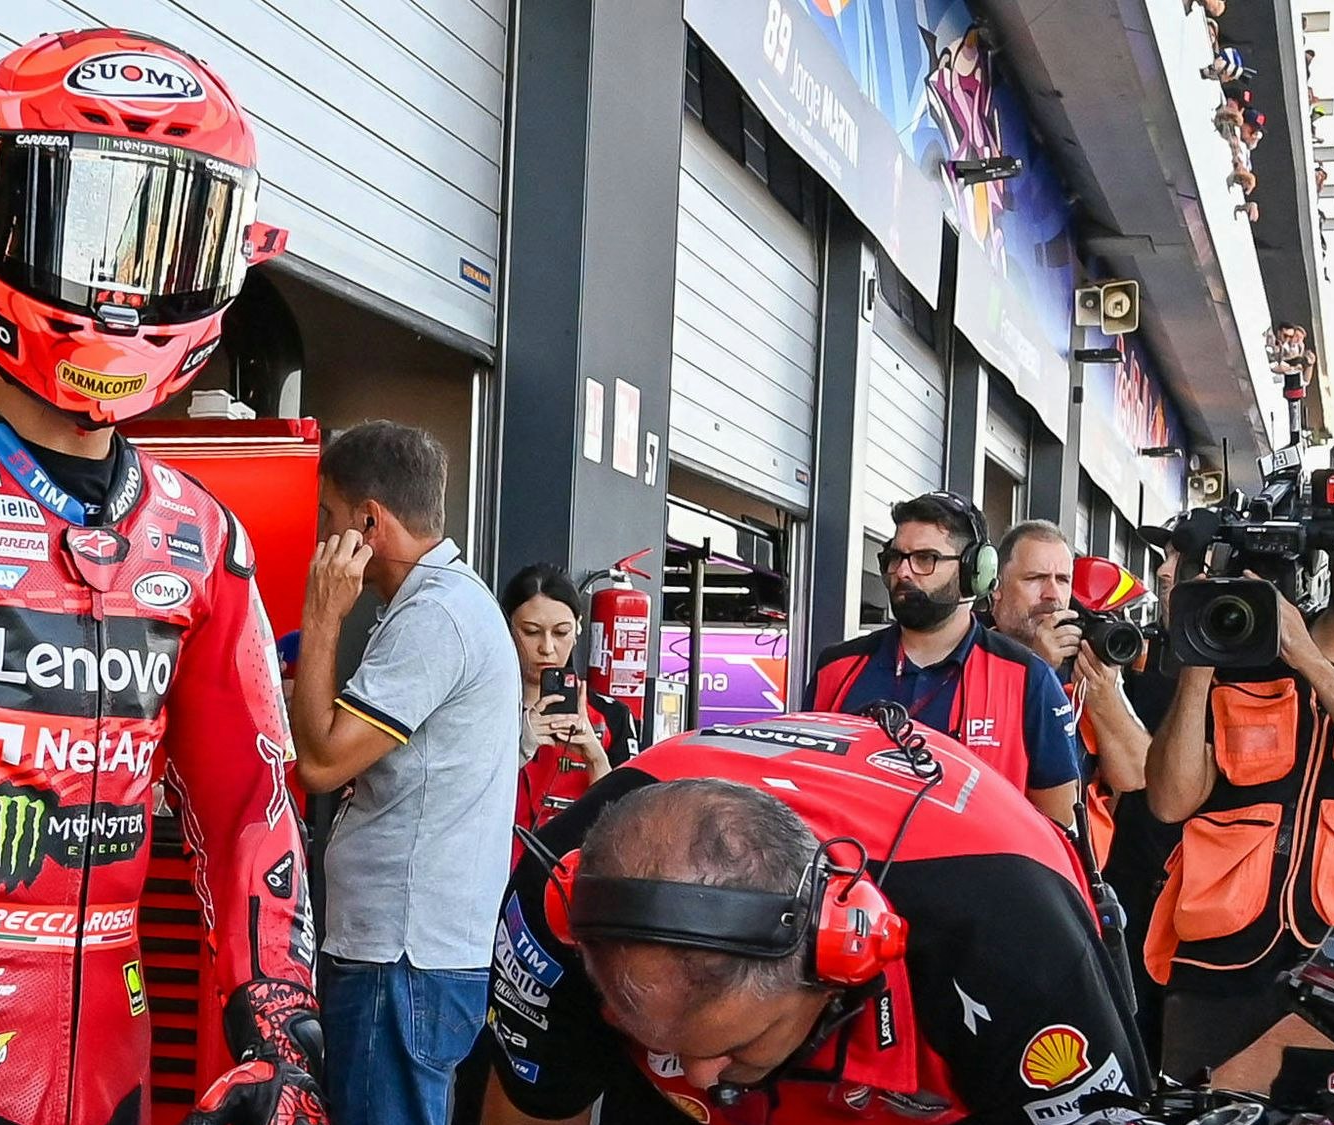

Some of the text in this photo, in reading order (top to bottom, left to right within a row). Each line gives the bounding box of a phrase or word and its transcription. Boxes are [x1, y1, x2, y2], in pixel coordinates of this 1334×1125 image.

[81, 62, 194, 96] SUOMY
[790, 48, 821, 127] Jorge
[822, 85, 859, 168] MARTIN
[16, 134, 69, 147] CARRERA
[62, 367, 143, 396] PARMACOTTO
[30, 469, 69, 513] TIM
[110, 467, 140, 521] Lenovo
[167, 536, 200, 554] Lenovo
[139, 582, 185, 602] SUOMY
[48, 812, 144, 842] MONSTER
[517, 931, 548, 976] TIM
[880, 996, 894, 1046] Lenovo
